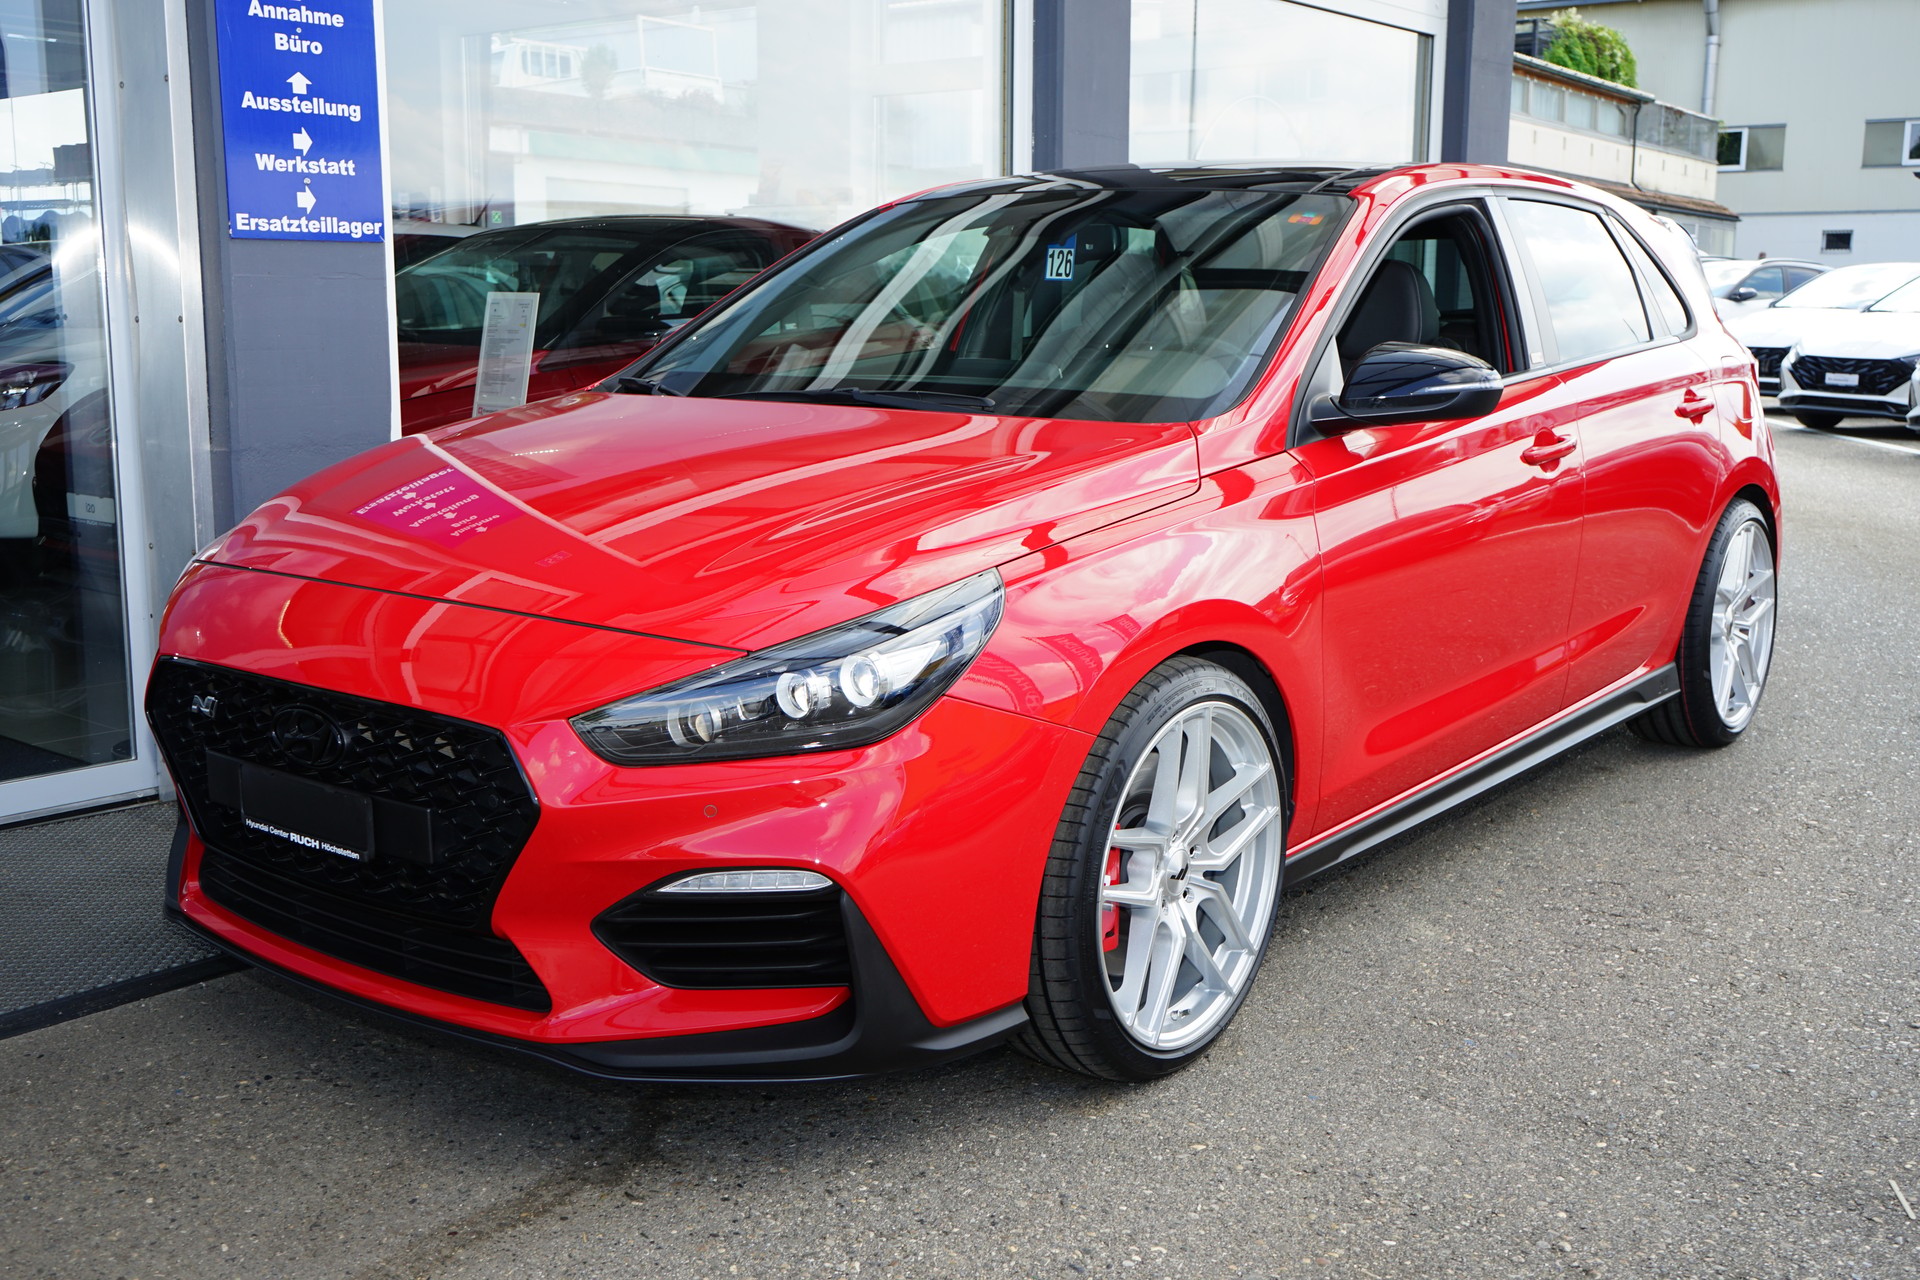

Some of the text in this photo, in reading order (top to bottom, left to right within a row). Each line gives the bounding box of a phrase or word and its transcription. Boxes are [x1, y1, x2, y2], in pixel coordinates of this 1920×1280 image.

[248, 0, 344, 27] Annahme
[274, 32, 323, 55] Büro
[241, 91, 361, 122] Ausstellung
[255, 153, 356, 176] Werkstatt
[235, 213, 382, 238] Ersatzteillager
[1048, 250, 1073, 277] 126
[245, 818, 360, 860] Hyundai Center RUCH Höchstetten
